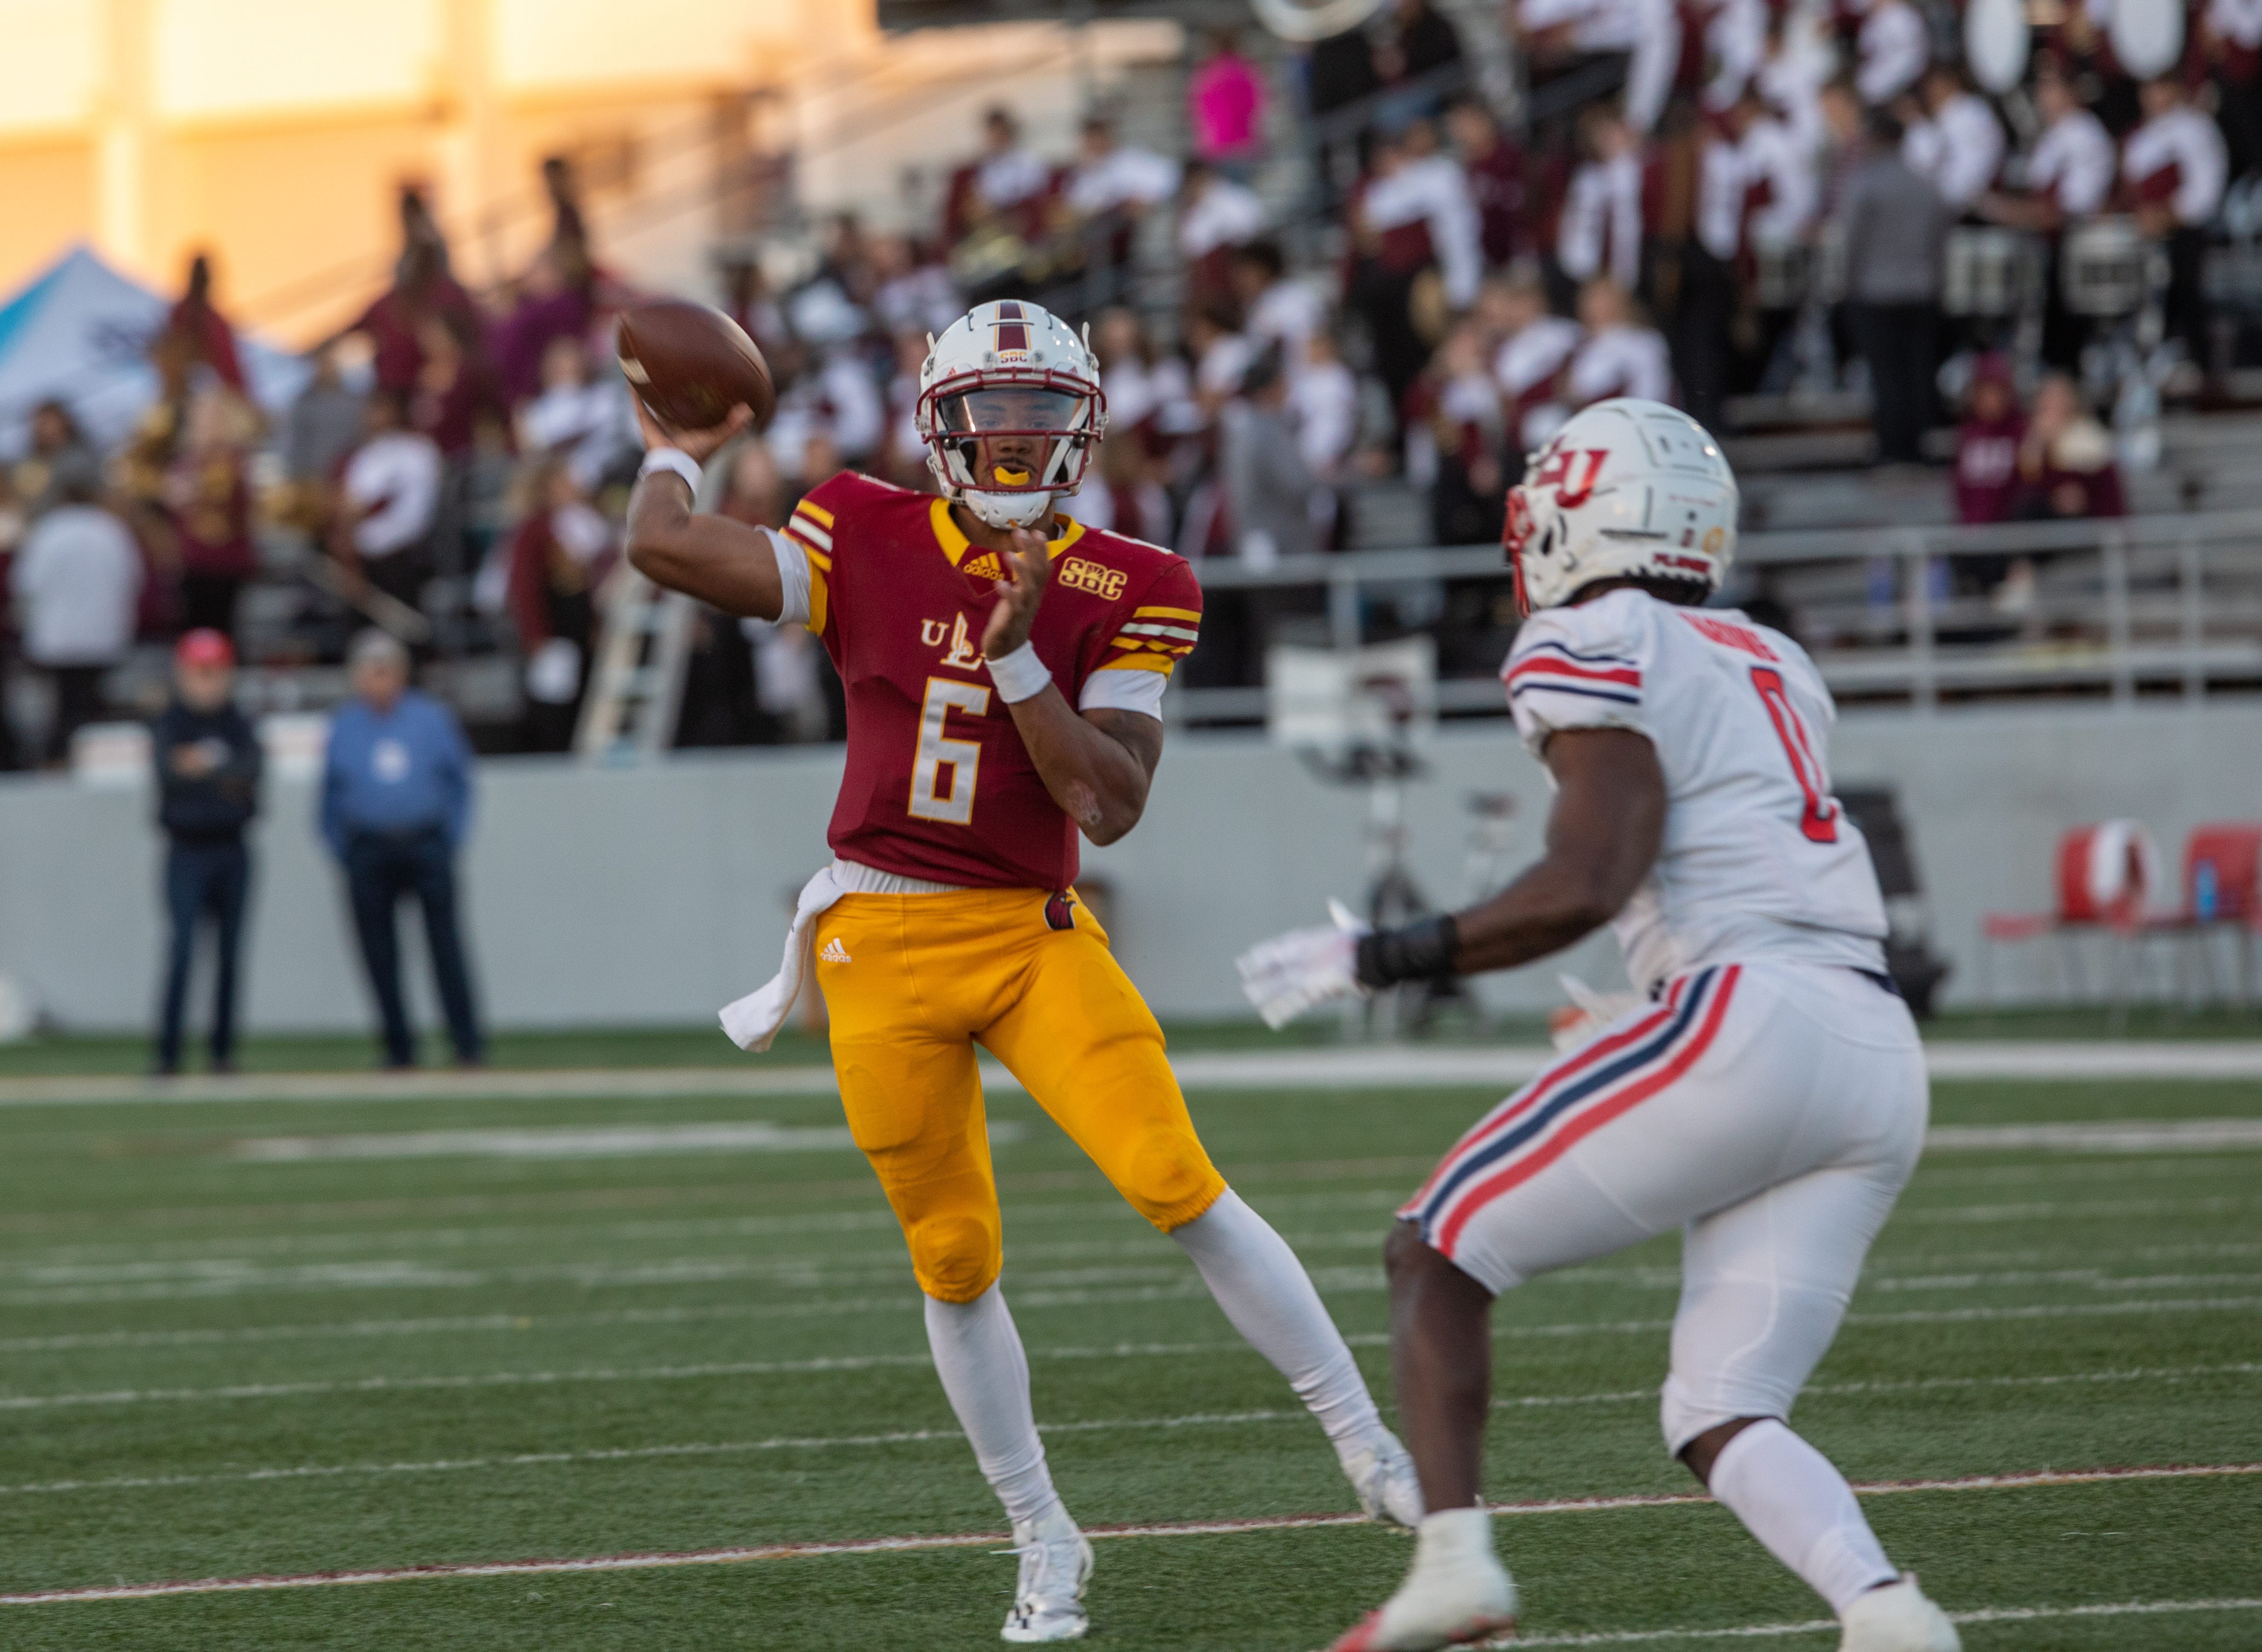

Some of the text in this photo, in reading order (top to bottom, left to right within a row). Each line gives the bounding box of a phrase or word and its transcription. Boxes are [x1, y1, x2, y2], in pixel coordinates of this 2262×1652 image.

[1000, 351, 1027, 363] SBC
[1058, 556, 1128, 601] SBC
[921, 611, 986, 671] UL
[908, 676, 991, 825] 6
[820, 952, 852, 963] adidas
